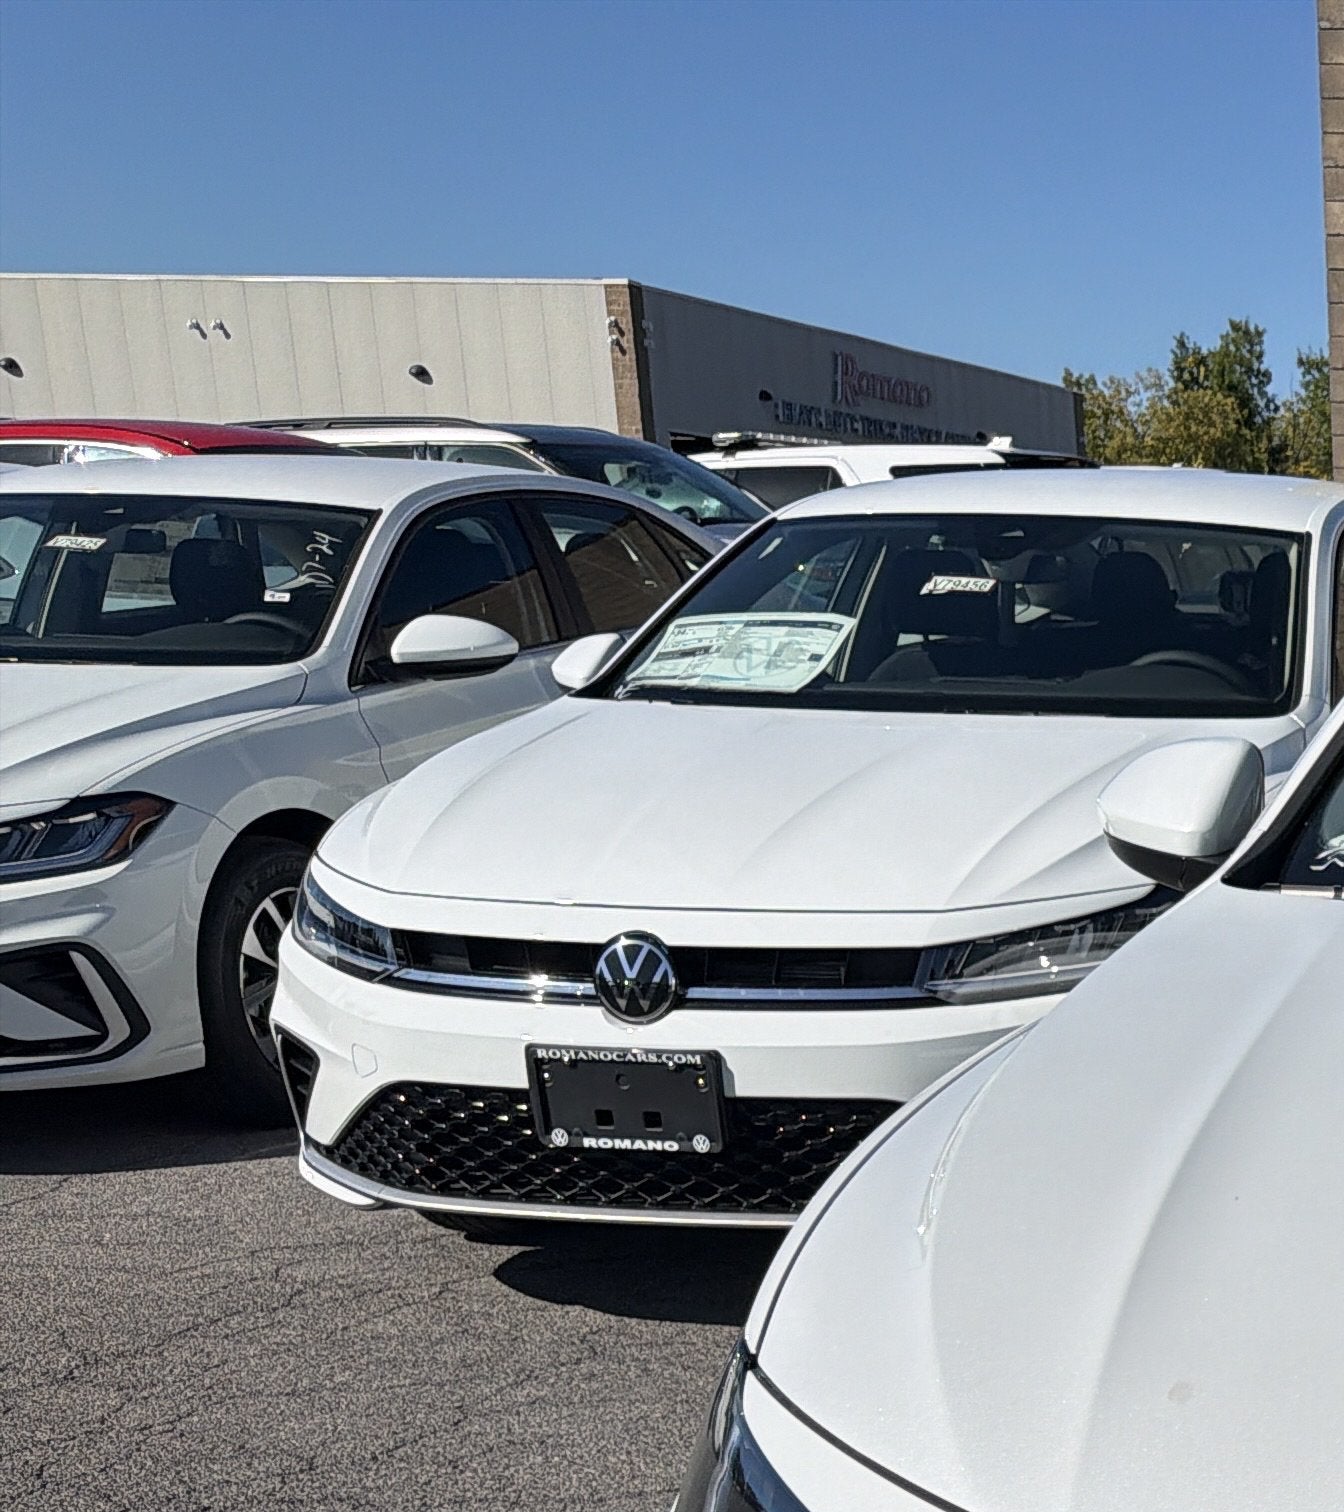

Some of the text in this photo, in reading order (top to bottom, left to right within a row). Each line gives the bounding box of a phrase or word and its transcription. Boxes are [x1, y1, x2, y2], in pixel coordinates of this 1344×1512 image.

[932, 578, 990, 591] V79456
[536, 1048, 702, 1065] ROMANOCARS.COM
[582, 1136, 680, 1152] ROMANO
